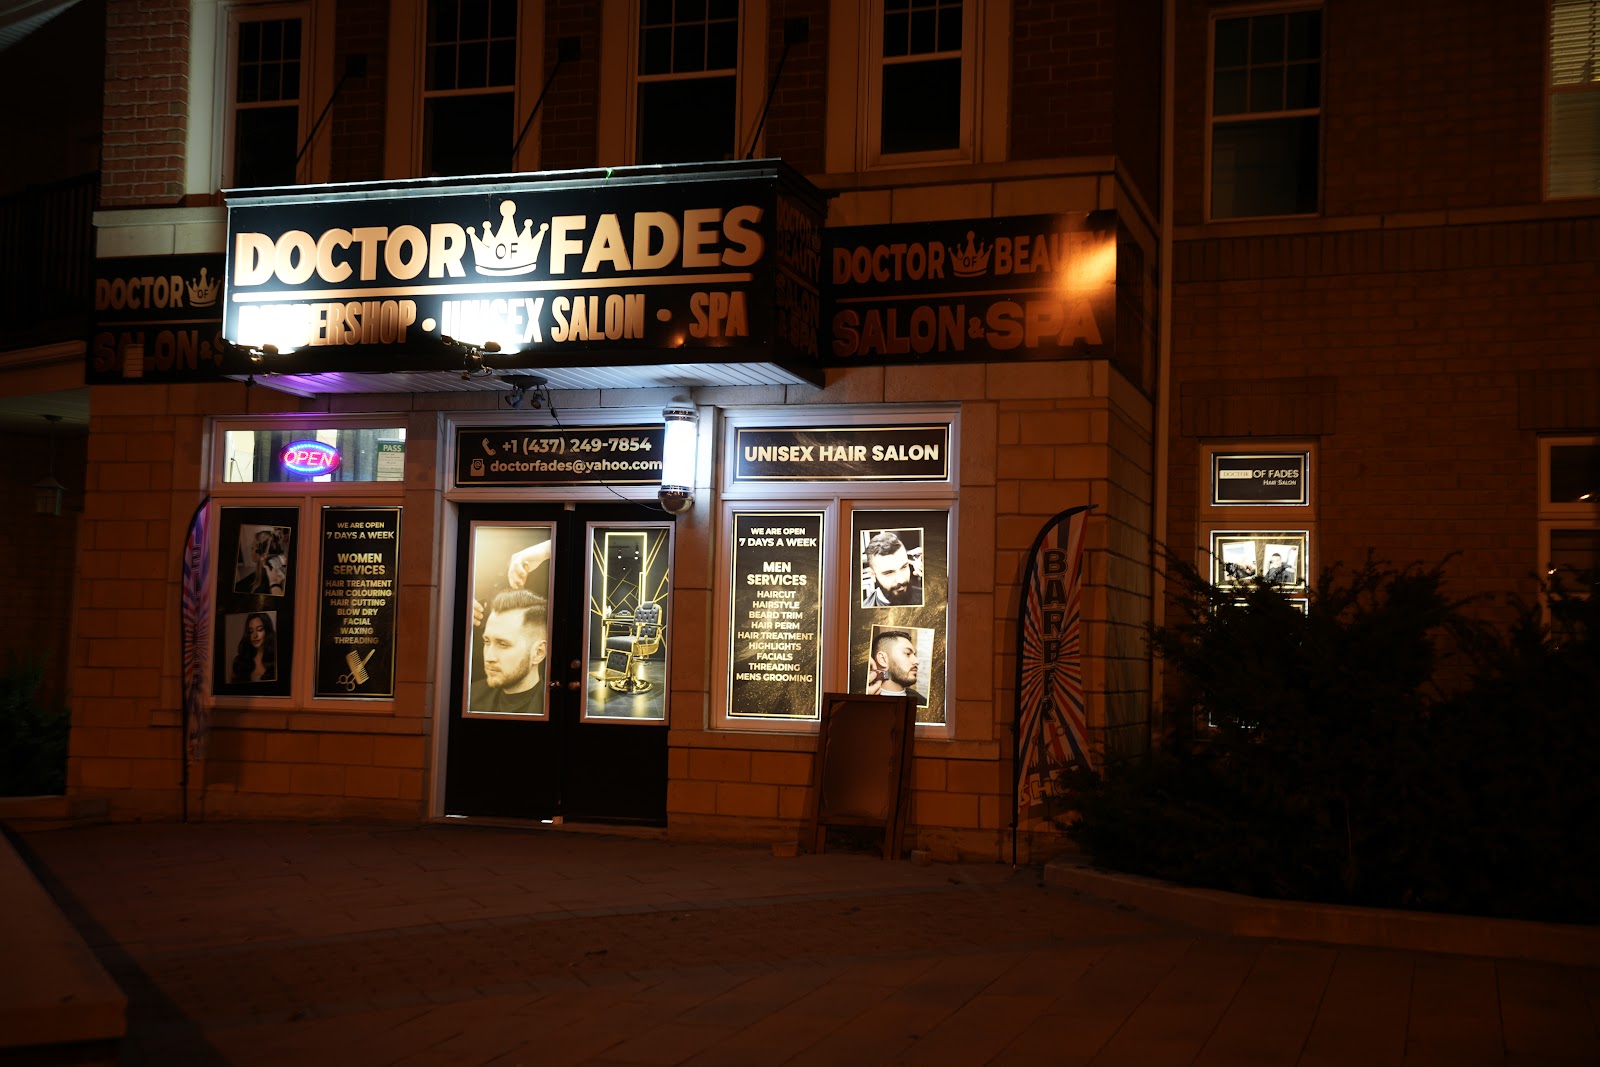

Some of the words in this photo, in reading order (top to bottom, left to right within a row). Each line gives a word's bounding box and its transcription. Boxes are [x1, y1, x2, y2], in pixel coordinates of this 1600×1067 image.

[234, 222, 466, 287] DOCTOR
[495, 242, 519, 259] OF
[549, 205, 766, 275] FADES
[832, 241, 945, 285] DOCTOR
[963, 256, 977, 268] OF
[95, 274, 184, 311] DOCTOR
[197, 289, 209, 298] OF
[237, 300, 417, 347] ERSHOP
[550, 293, 646, 343] SALON
[688, 291, 749, 338] SPA
[832, 304, 965, 358] SALON
[986, 298, 1103, 352] SPA
[94, 329, 199, 373] SALON
[383, 444, 402, 452] PASS
[502, 440, 518, 454] +1
[522, 437, 566, 456] (437)
[569, 437, 652, 453] 249-7854
[744, 446, 814, 462] UNISEX
[819, 445, 867, 462] HAIR
[871, 444, 939, 461] SALON
[284, 451, 334, 467] OPEN
[490, 458, 663, 474] doctorfades@yahoo.com
[1253, 470, 1266, 478] OF
[1268, 469, 1299, 478] FADES
[751, 527, 763, 535] WE
[765, 527, 781, 535] ARE
[783, 527, 805, 535] OPEN
[327, 532, 332, 540] 7
[334, 532, 357, 540] DAYS
[359, 532, 366, 540] A
[368, 532, 394, 540] WEEK
[739, 538, 745, 547] 7
[748, 538, 774, 547] DAYS
[776, 538, 784, 547] A
[786, 538, 816, 547] WEEK
[338, 553, 382, 563] WOMEN
[333, 564, 385, 575] SERVICES
[763, 562, 791, 573] MEN
[747, 574, 806, 586] SERVICES
[325, 589, 344, 597] HAIR
[346, 589, 392, 597] COLOURING
[757, 590, 796, 598] HAIRCUT
[330, 598, 349, 606] HAIR
[351, 598, 386, 606] CUTTING
[753, 601, 799, 609] HAIRSTYLE
[337, 608, 359, 616] BLOW
[361, 608, 378, 616] DRY
[749, 611, 780, 620] BEARD
[782, 611, 802, 620] TRIM
[751, 622, 773, 630] HAIR
[775, 622, 800, 630] PERM
[340, 627, 373, 635] WAXING
[334, 636, 379, 644] THREADING
[738, 632, 759, 640] HAIR
[761, 632, 814, 640] TREATMENT
[749, 642, 801, 650] HIGHLIGHTS
[757, 652, 792, 660] FACIALS
[749, 663, 800, 671] THREADING
[736, 673, 761, 682] MENS
[763, 673, 812, 682] GROOMING
